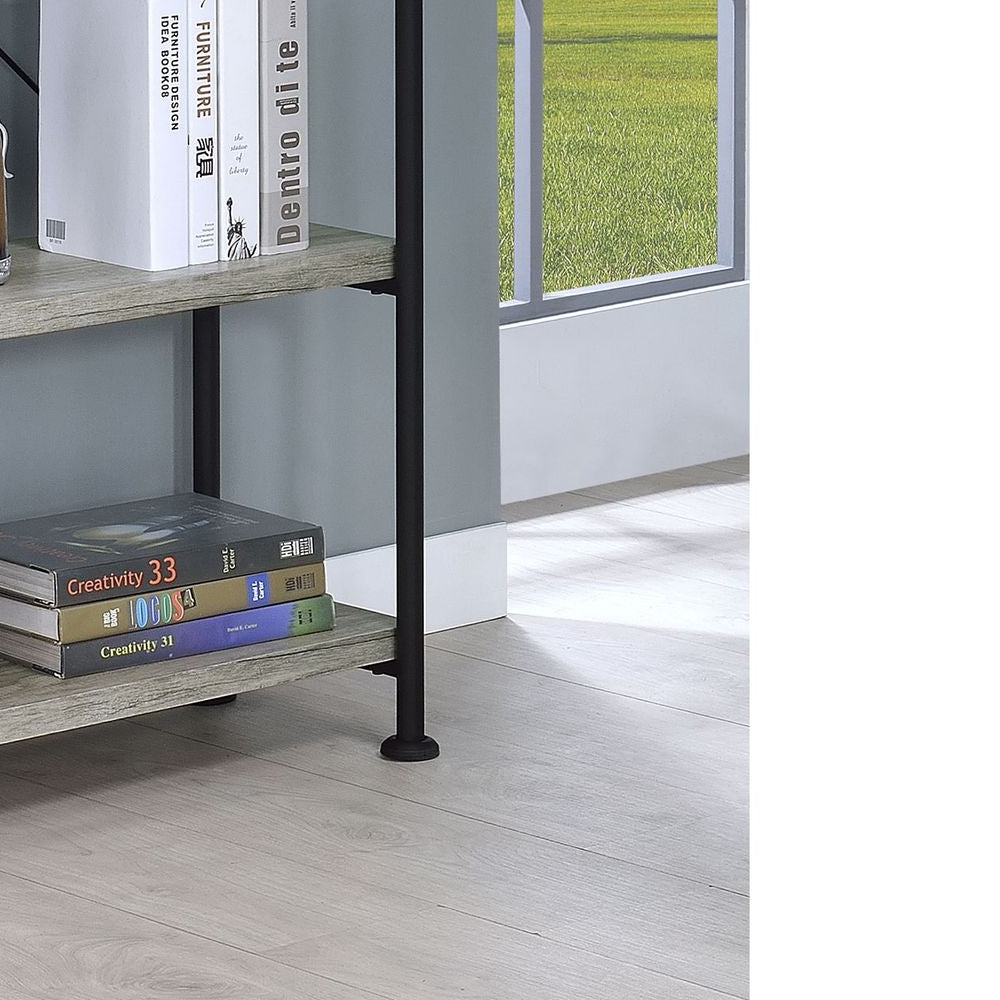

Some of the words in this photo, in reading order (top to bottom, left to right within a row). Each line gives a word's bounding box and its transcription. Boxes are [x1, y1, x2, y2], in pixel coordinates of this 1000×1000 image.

[161, 16, 169, 44] IDEA
[171, 15, 179, 83] FURNITURE
[161, 50, 170, 98] BOOK08
[196, 21, 211, 118] FURNITURE
[275, 40, 300, 73] te
[171, 87, 179, 131] DESIGN
[275, 82, 300, 116] di
[277, 130, 301, 246] Dentro
[67, 570, 144, 596] Creativity
[147, 556, 178, 586] 33
[100, 638, 158, 659] Creativity
[160, 634, 174, 648] 31
